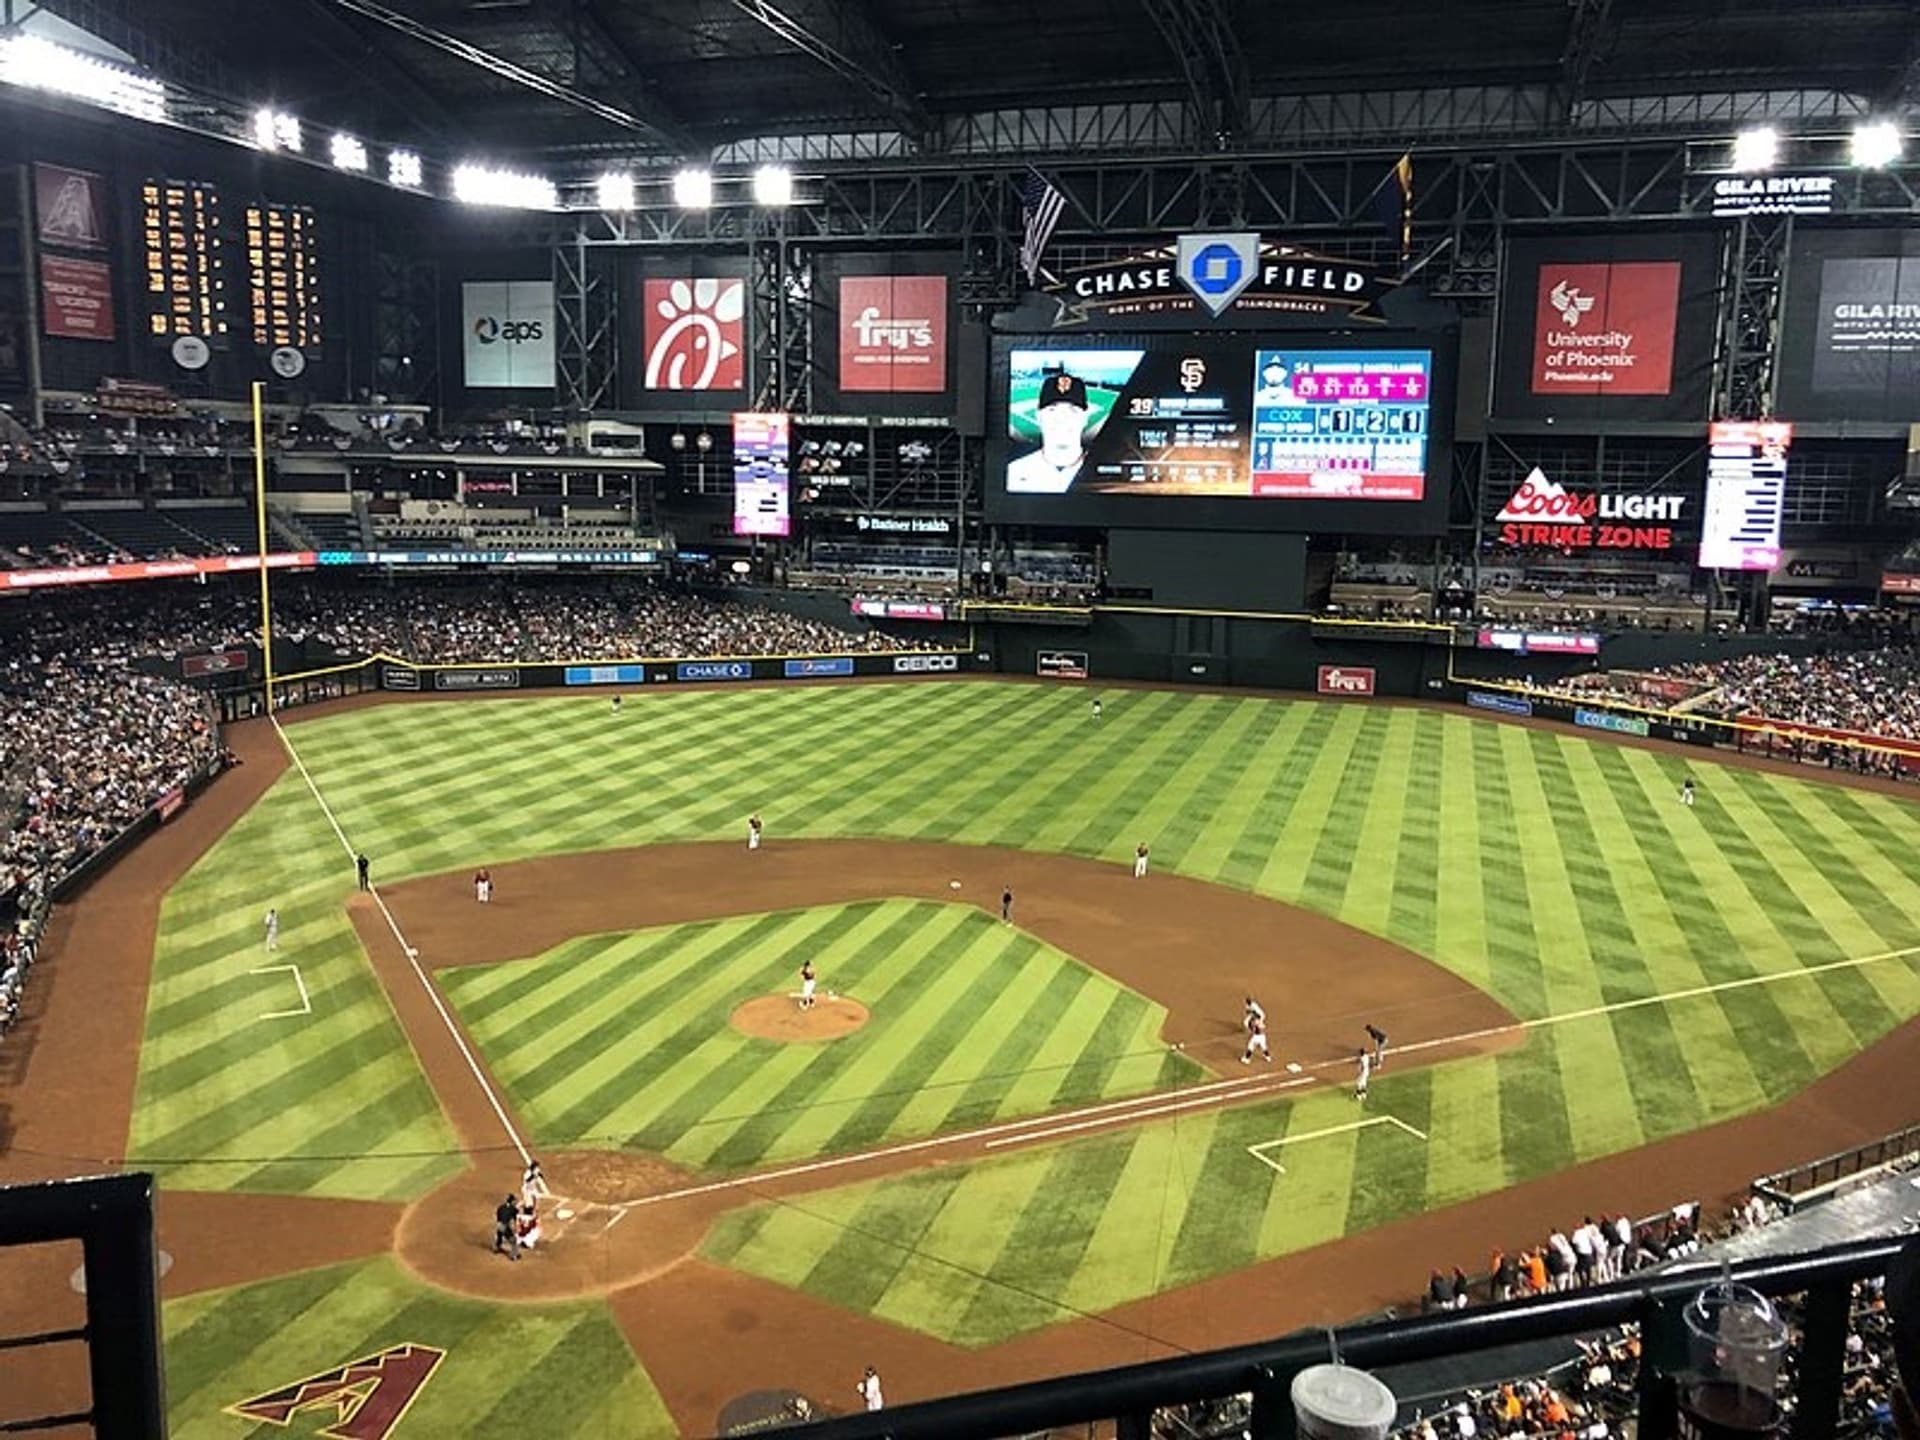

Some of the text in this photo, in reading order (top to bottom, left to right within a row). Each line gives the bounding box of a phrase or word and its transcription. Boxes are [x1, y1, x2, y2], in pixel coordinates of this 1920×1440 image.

[1715, 177, 1832, 195] GILA RIVER
[1075, 265, 1365, 297] CHASE FIELD
[1108, 299, 1326, 314] HOME OF THE DIAMONDBACKS
[1835, 304, 1885, 318] GILA
[502, 321, 543, 344] aps
[852, 307, 934, 350] fry's
[1547, 331, 1633, 349] University
[1545, 351, 1634, 366] of Phoenix
[1130, 398, 1152, 414] 39
[1269, 410, 1303, 422] COX
[1370, 411, 1383, 432] 2
[1506, 483, 1685, 520] Coors LIGHT
[912, 519, 950, 532] Health
[1503, 524, 1672, 548] STRIKE ZONE
[319, 552, 352, 565] COX
[686, 664, 729, 677] CHASE
[895, 656, 957, 672] GEICO
